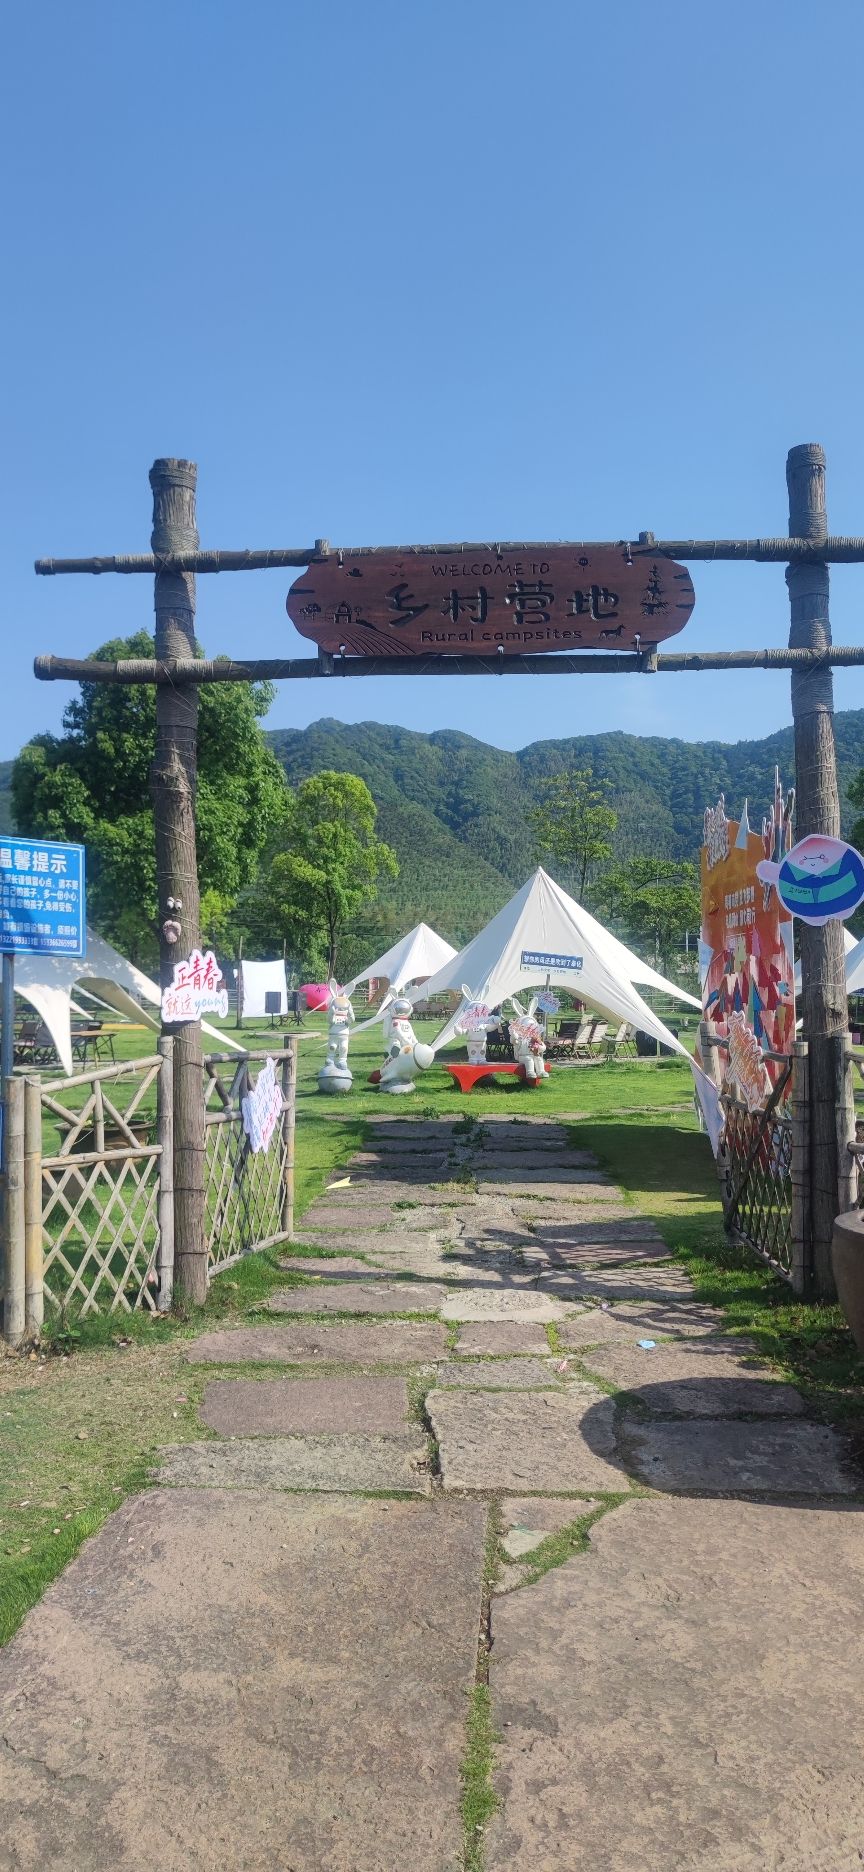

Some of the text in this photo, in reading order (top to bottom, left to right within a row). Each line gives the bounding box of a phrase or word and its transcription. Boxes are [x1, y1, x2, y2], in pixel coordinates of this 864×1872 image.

[432, 562, 550, 577] WELCOME TO
[385, 579, 619, 627] 乡村营地
[421, 629, 583, 643] Rural campsites
[174, 955, 219, 991] 正青春
